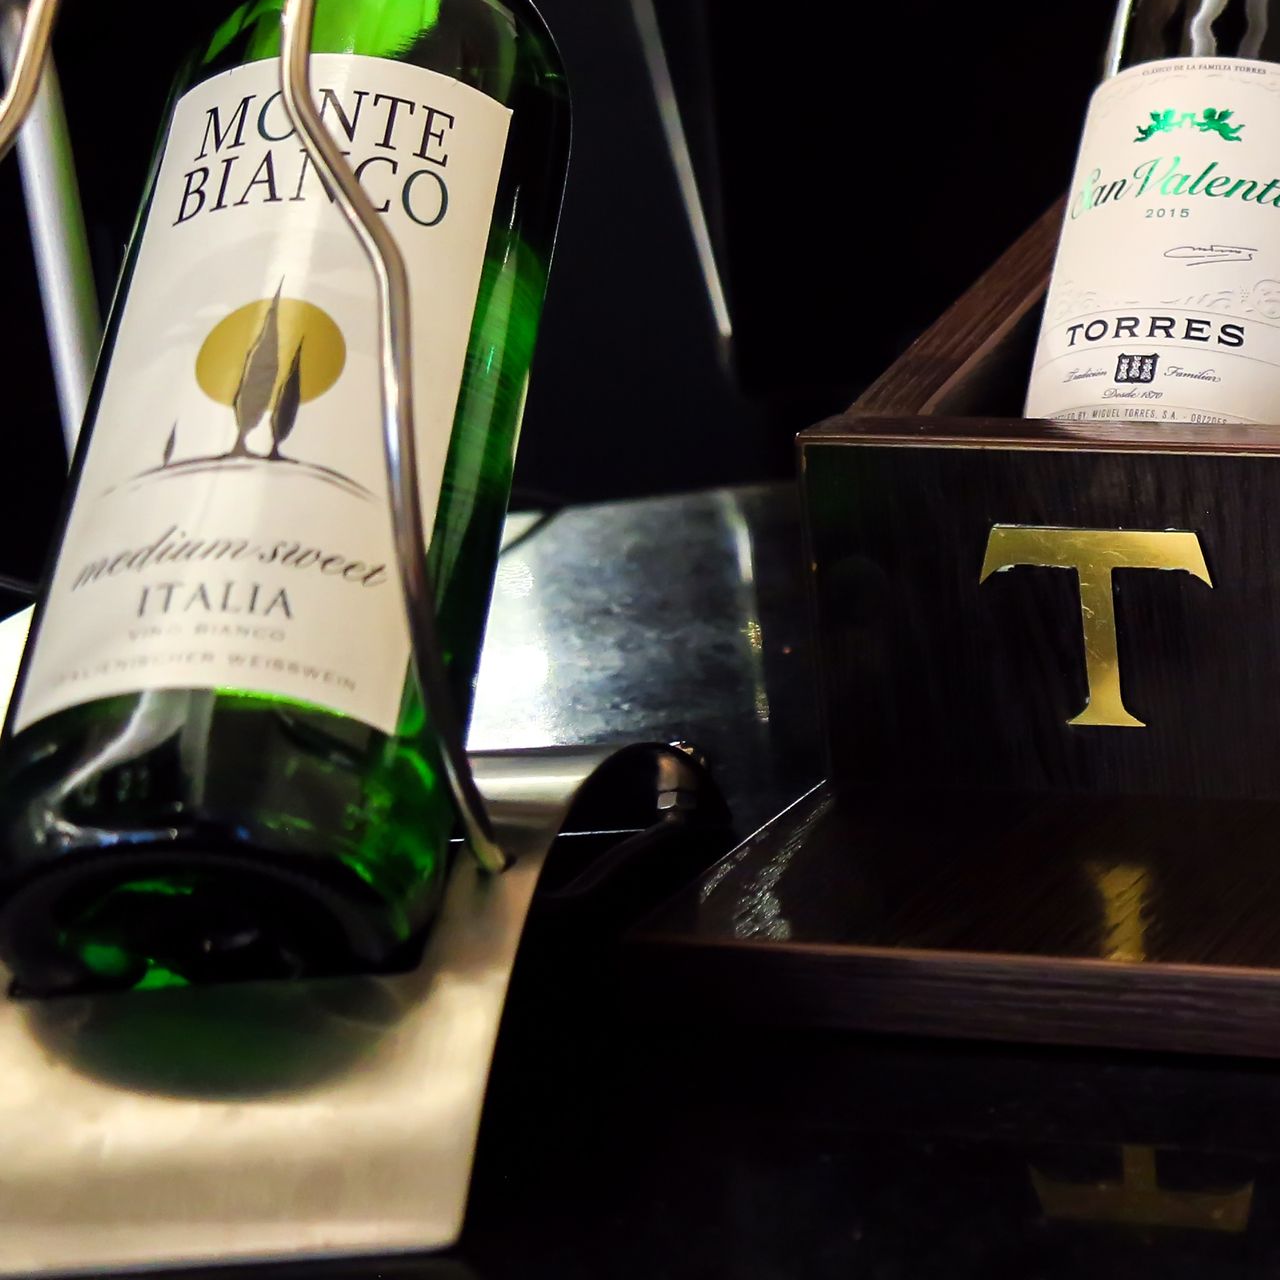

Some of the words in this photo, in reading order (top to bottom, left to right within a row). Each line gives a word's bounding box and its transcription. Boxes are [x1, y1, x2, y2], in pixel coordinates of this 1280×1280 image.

[1235, 65, 1267, 75] TORRES
[194, 88, 455, 167] MONTE
[1071, 168, 1130, 219] San
[1145, 208, 1190, 218] 2015
[1066, 316, 1245, 348] TORRES
[1163, 365, 1222, 383] Familiar
[1140, 391, 1163, 399] 1870
[1092, 406, 1121, 419] MIGUEL
[72, 525, 249, 591] medium
[258, 540, 386, 587] sweet
[137, 581, 293, 619] ITALIA
[194, 623, 286, 641] BIANCO
